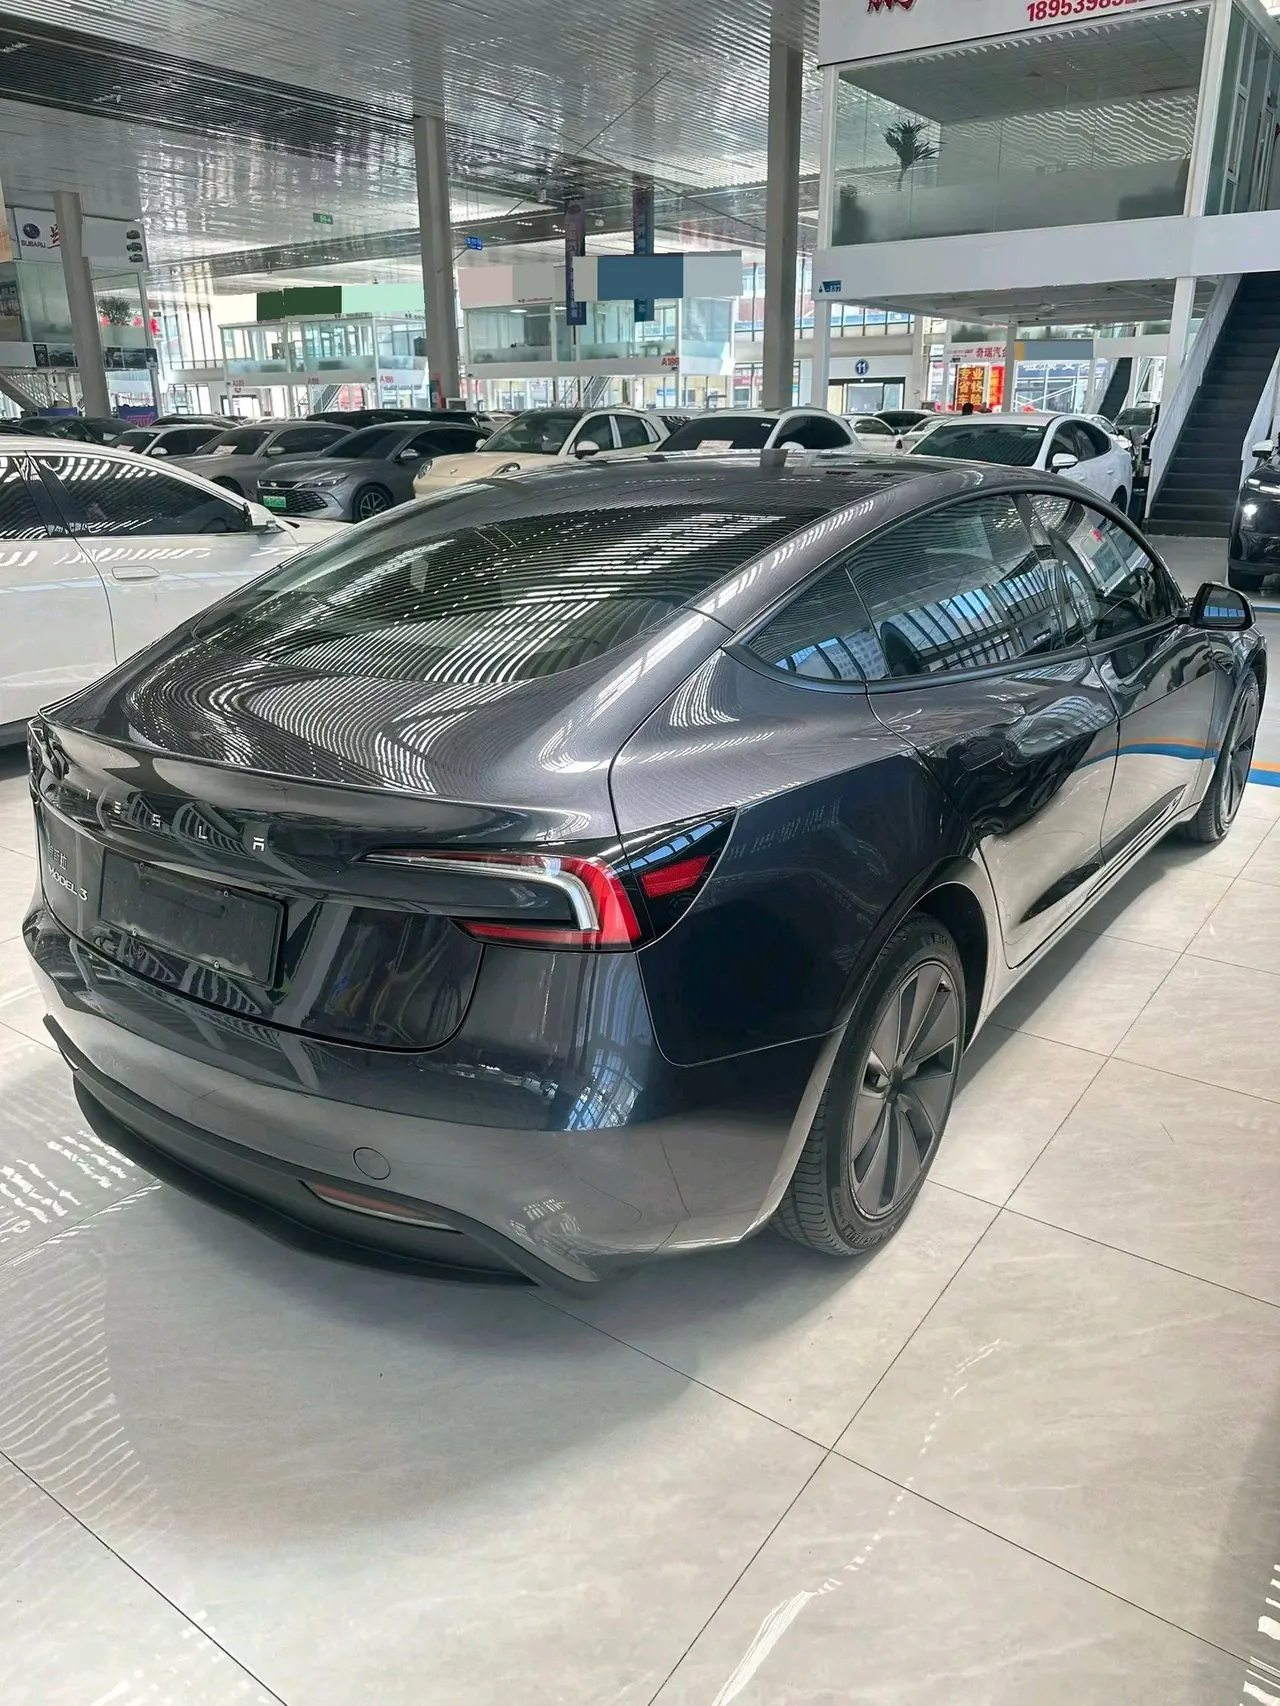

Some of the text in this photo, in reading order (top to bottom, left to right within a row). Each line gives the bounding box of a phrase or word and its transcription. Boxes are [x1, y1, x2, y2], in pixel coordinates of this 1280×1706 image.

[20, 239, 47, 249] SUBARU
[856, 361, 867, 374] 11
[85, 787, 265, 852] TESLA
[48, 864, 89, 901] MODEL 3
